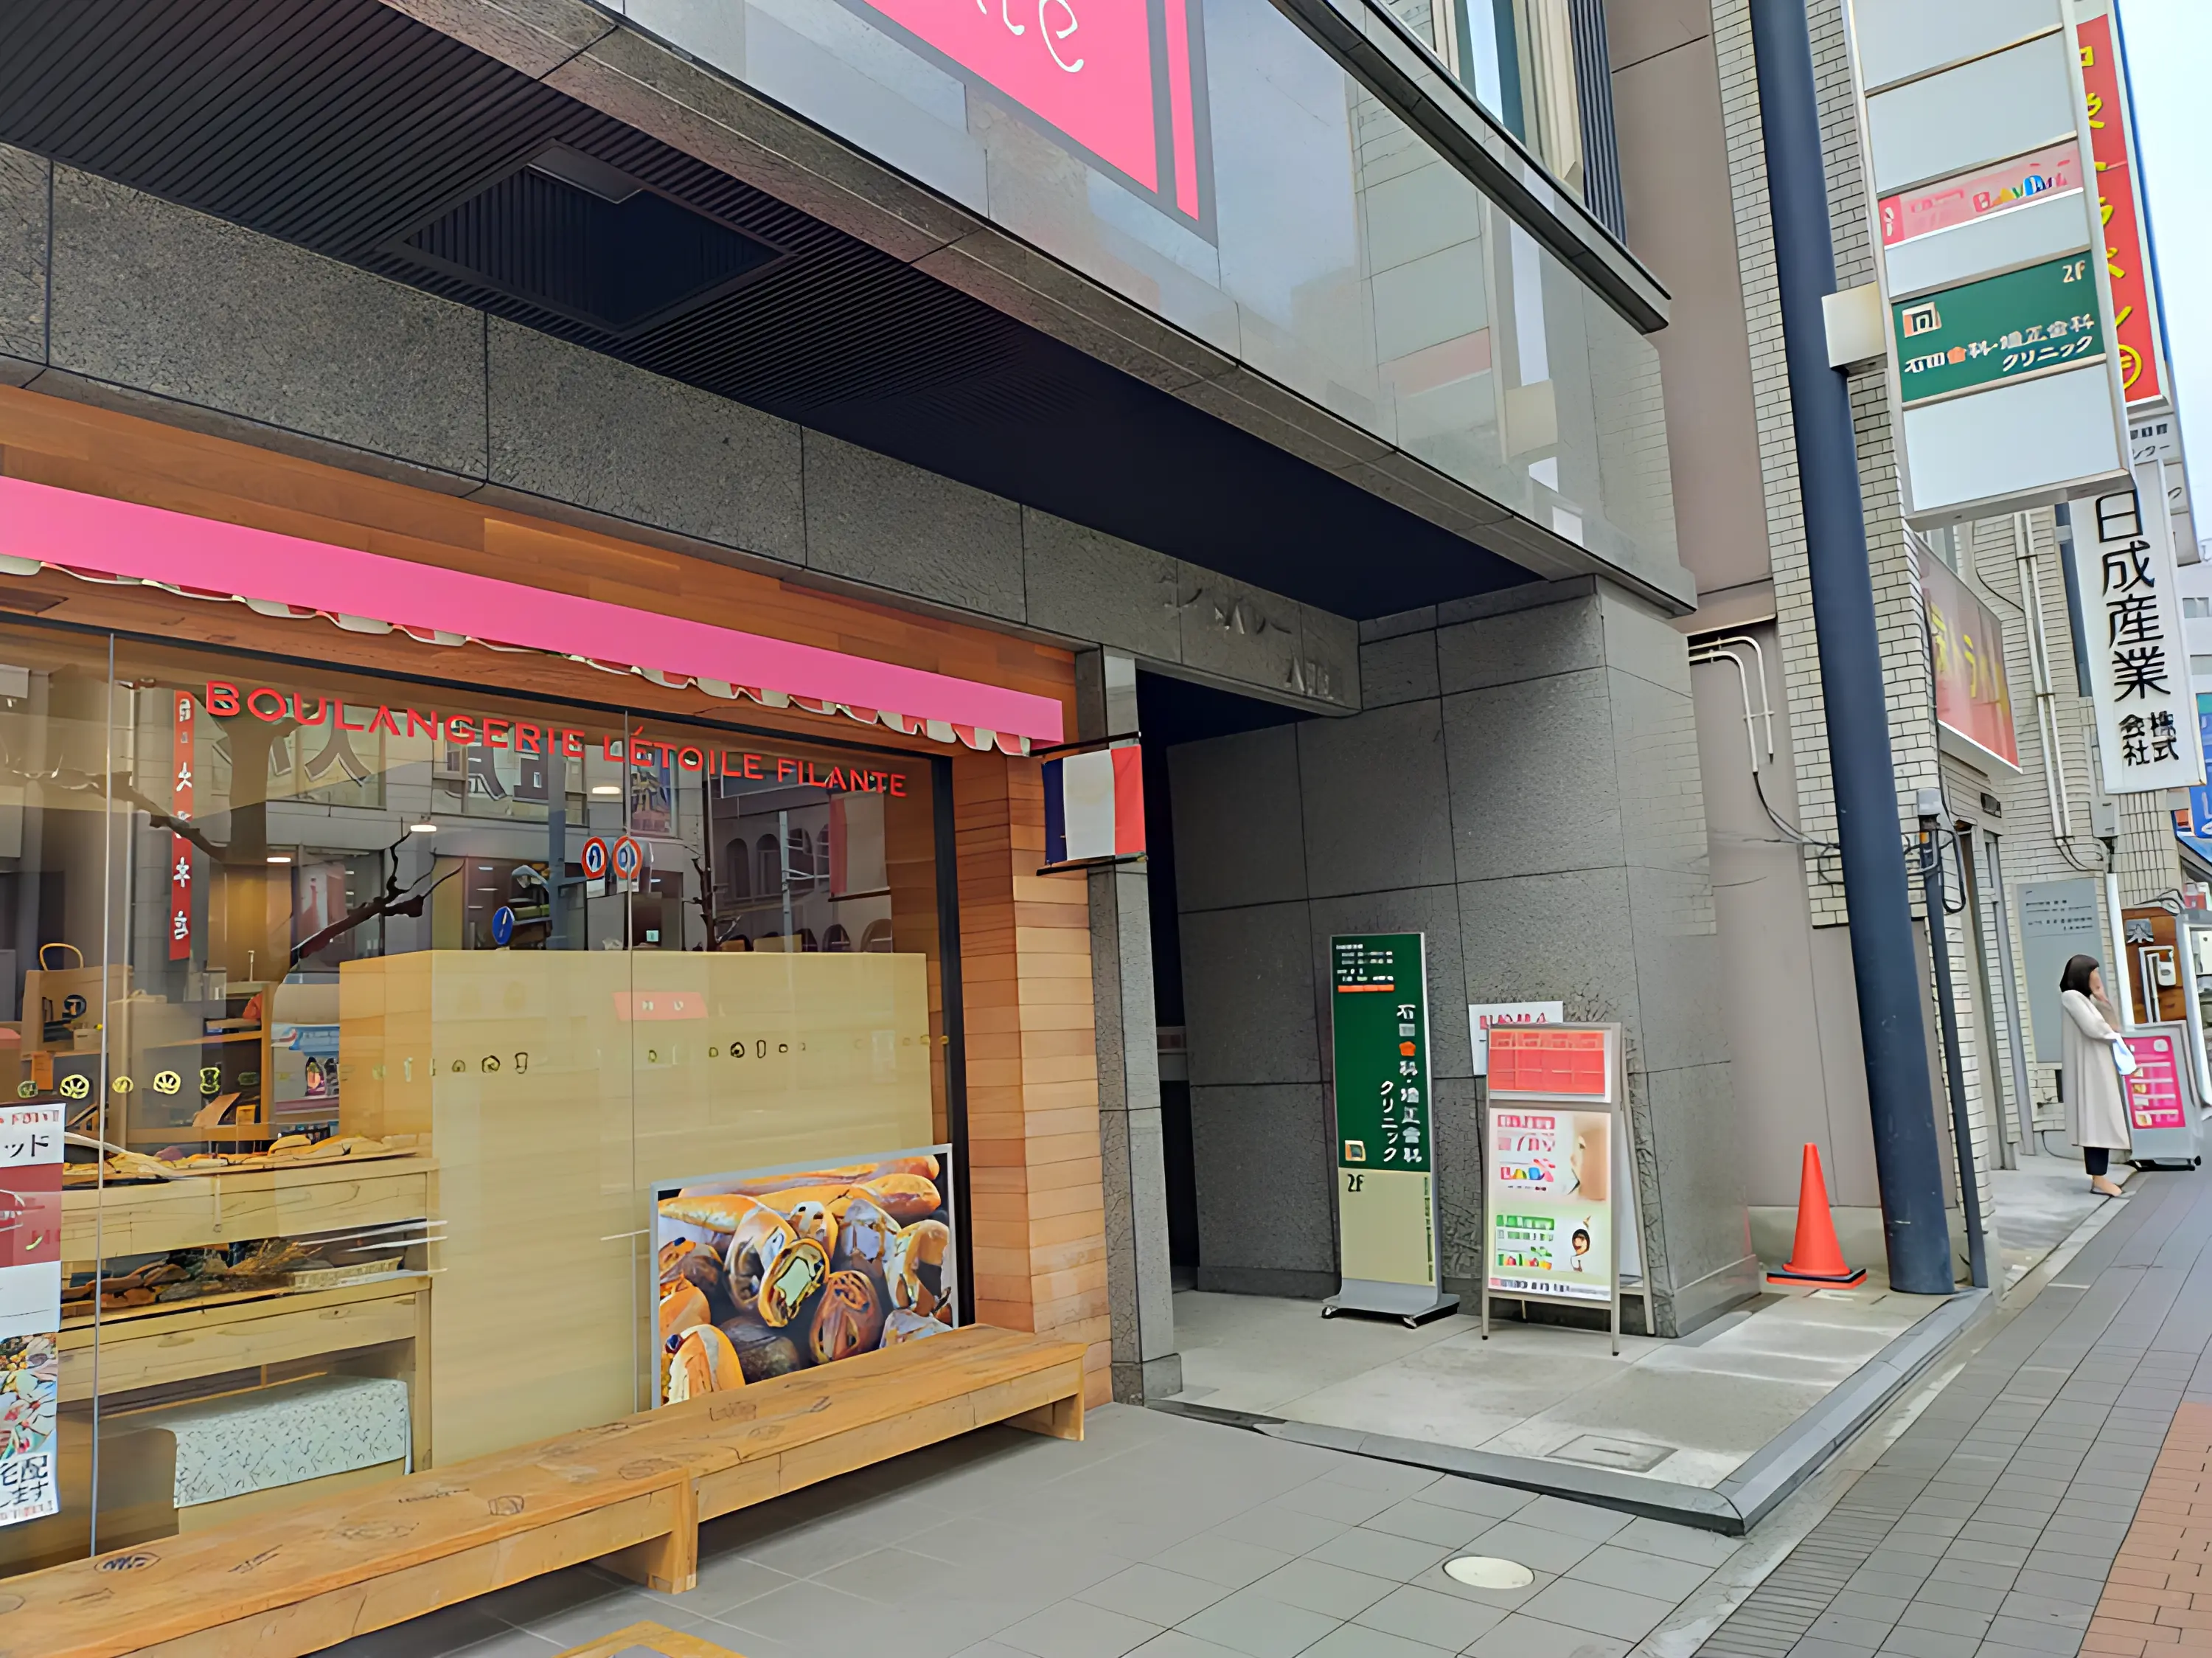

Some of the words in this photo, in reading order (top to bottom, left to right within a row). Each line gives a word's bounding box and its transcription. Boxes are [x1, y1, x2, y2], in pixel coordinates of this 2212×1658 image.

[2096, 489, 2171, 703] 日成産業
[206, 680, 585, 759] BOULANGERIE
[777, 759, 908, 797] FILANTE
[1380, 1081, 1399, 1162] クリニック
[1347, 1173, 1365, 1193] 2F
